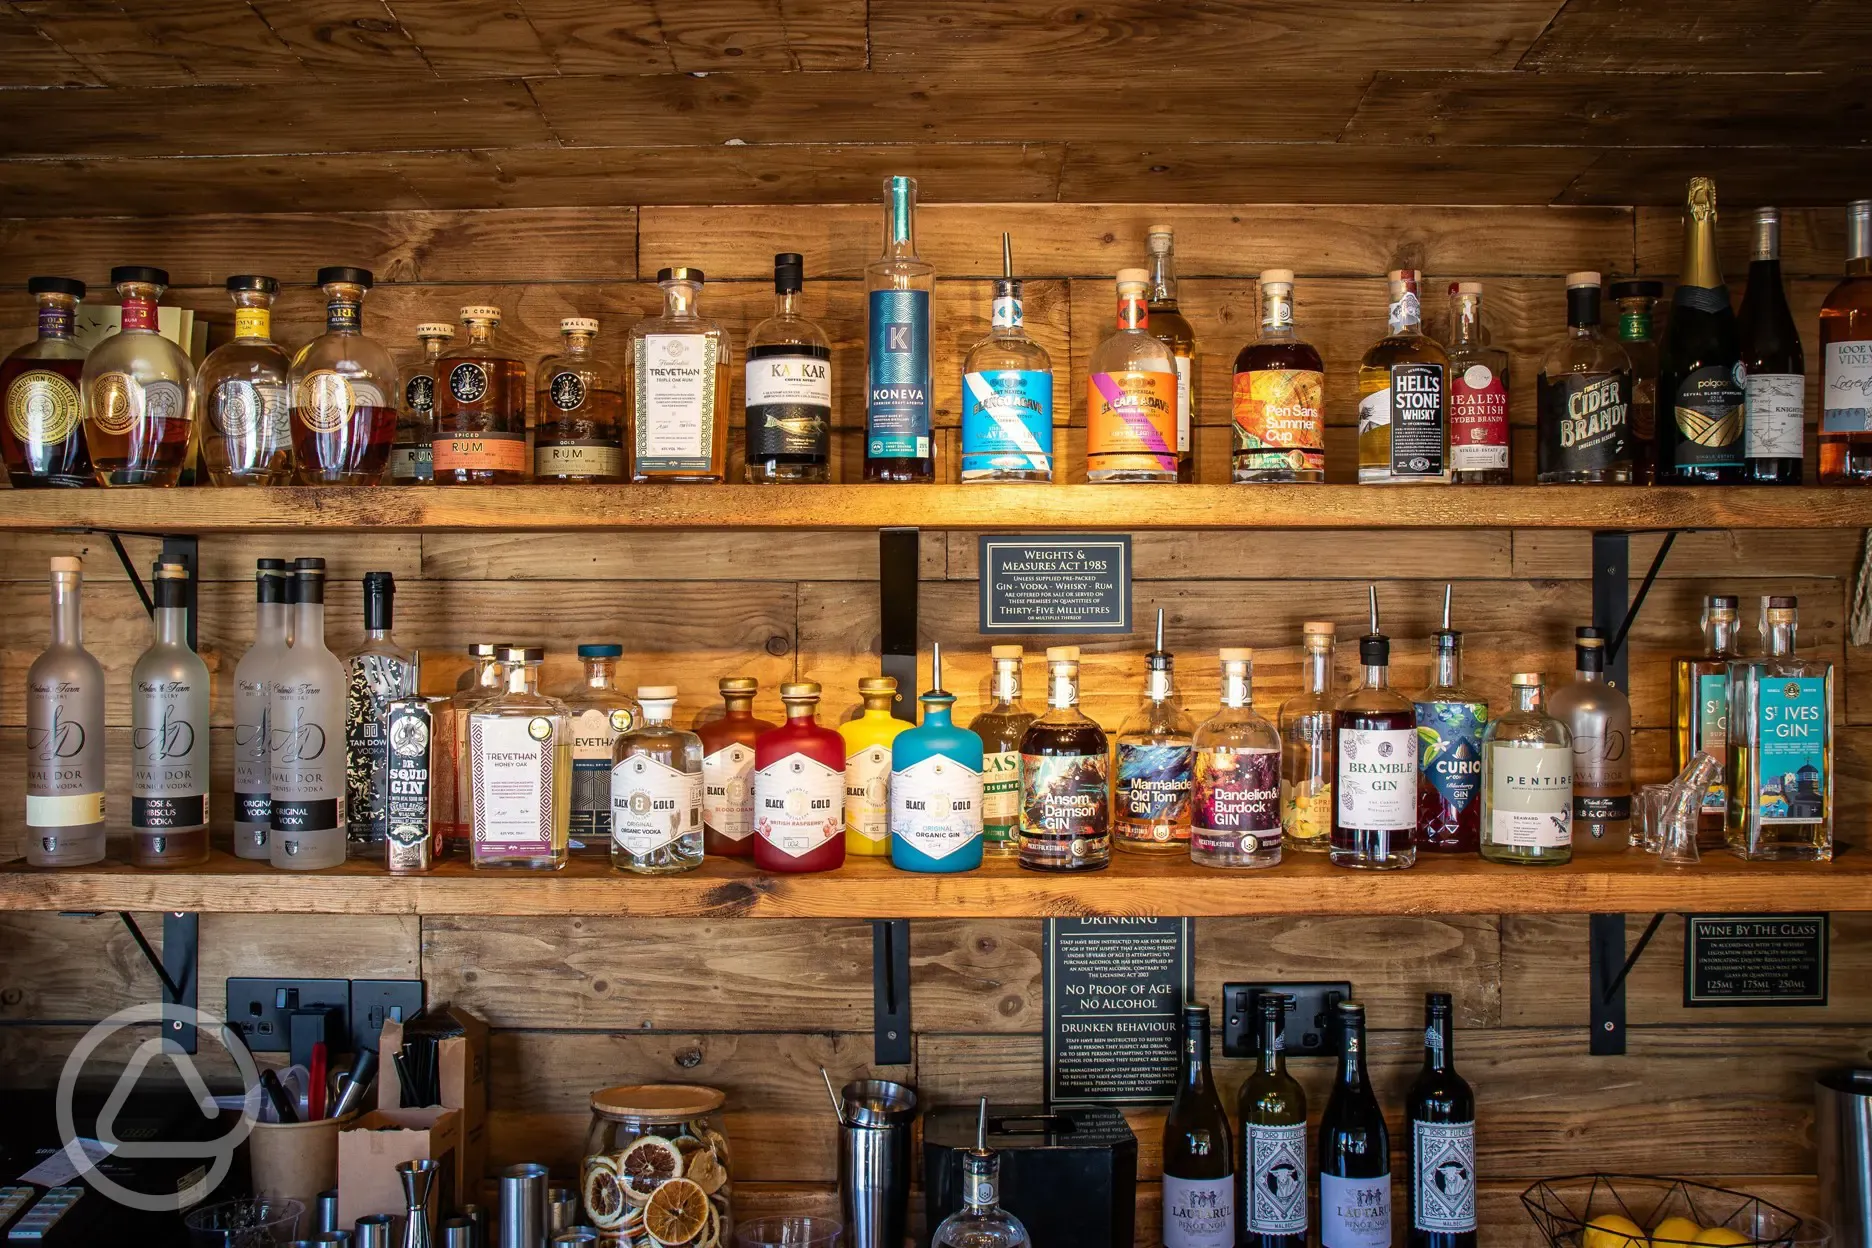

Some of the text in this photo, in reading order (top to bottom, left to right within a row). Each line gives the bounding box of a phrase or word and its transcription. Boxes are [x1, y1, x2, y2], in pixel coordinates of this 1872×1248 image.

[890, 327, 908, 350] K
[1838, 345, 1866, 354] LOOE
[650, 368, 700, 376] TREVETHAN
[1396, 375, 1439, 392] HELL'S
[873, 390, 924, 400] KONEVA
[1396, 393, 1439, 409] STONE
[1568, 382, 1620, 420] CIDER
[1266, 404, 1318, 417] Pen Sans
[1402, 409, 1435, 420] WHISKY
[1450, 406, 1504, 415] CORNISH
[1266, 418, 1316, 429] Summer
[1560, 403, 1628, 447] BRANDY
[1266, 430, 1292, 443] Cup
[452, 442, 484, 452] RUM
[552, 448, 583, 459] RUM
[1024, 550, 1086, 559] WEIGHTS &
[1002, 561, 1107, 570] MEASURES ACT 1985
[55, 682, 80, 693] Farm
[166, 682, 190, 693] Farm
[298, 683, 320, 695] Farm
[1764, 706, 1819, 720] ST IVES
[1776, 724, 1808, 737] GIN
[402, 760, 414, 769] DR
[1349, 762, 1412, 773] BRAMBLE
[1436, 760, 1481, 774] CURIO
[54, 770, 82, 780] DOR
[164, 770, 192, 779] DOR
[297, 773, 324, 782] DOR
[390, 768, 427, 781] SQUID
[1131, 778, 1191, 790] Marmalade
[1372, 780, 1398, 791] GIN
[1507, 776, 1572, 785] PENTIRE
[391, 781, 425, 795] GIN
[707, 786, 725, 796] BLACK
[847, 787, 865, 796] BLACK
[1045, 793, 1088, 805] Ansom
[1131, 790, 1176, 802] Old Tom
[146, 800, 165, 808] ROSE
[614, 798, 675, 809] BLACK GOLD
[765, 799, 830, 809] BLACK GOLD
[906, 800, 971, 810] BLACK GOLD
[1130, 802, 1151, 813] GIN
[1214, 801, 1266, 813] Burdock
[143, 808, 177, 816] HIBISCUS
[246, 808, 271, 816] VODKA
[275, 808, 308, 816] ORIGINAL
[1045, 805, 1095, 816] Damson
[146, 816, 173, 826] VODKA
[1045, 818, 1069, 829] GIN
[1214, 814, 1240, 826] GIN
[1080, 917, 1158, 925] DRINKING
[1699, 924, 1816, 935] WINE BY THE GLASS
[1066, 984, 1172, 995] NO PROOF OF AGE
[1707, 980, 1806, 989] 125ML 175ML 250ML
[1080, 999, 1158, 1009] NO ALCOHOL
[1061, 1023, 1176, 1033] DRUNKEN BEHAVIOUR
[1262, 1131, 1278, 1139] TORO
[1172, 1205, 1232, 1219] LAUTARUL
[1178, 1221, 1226, 1229] PINOT NOIR
[1345, 1220, 1372, 1228] PINOT
